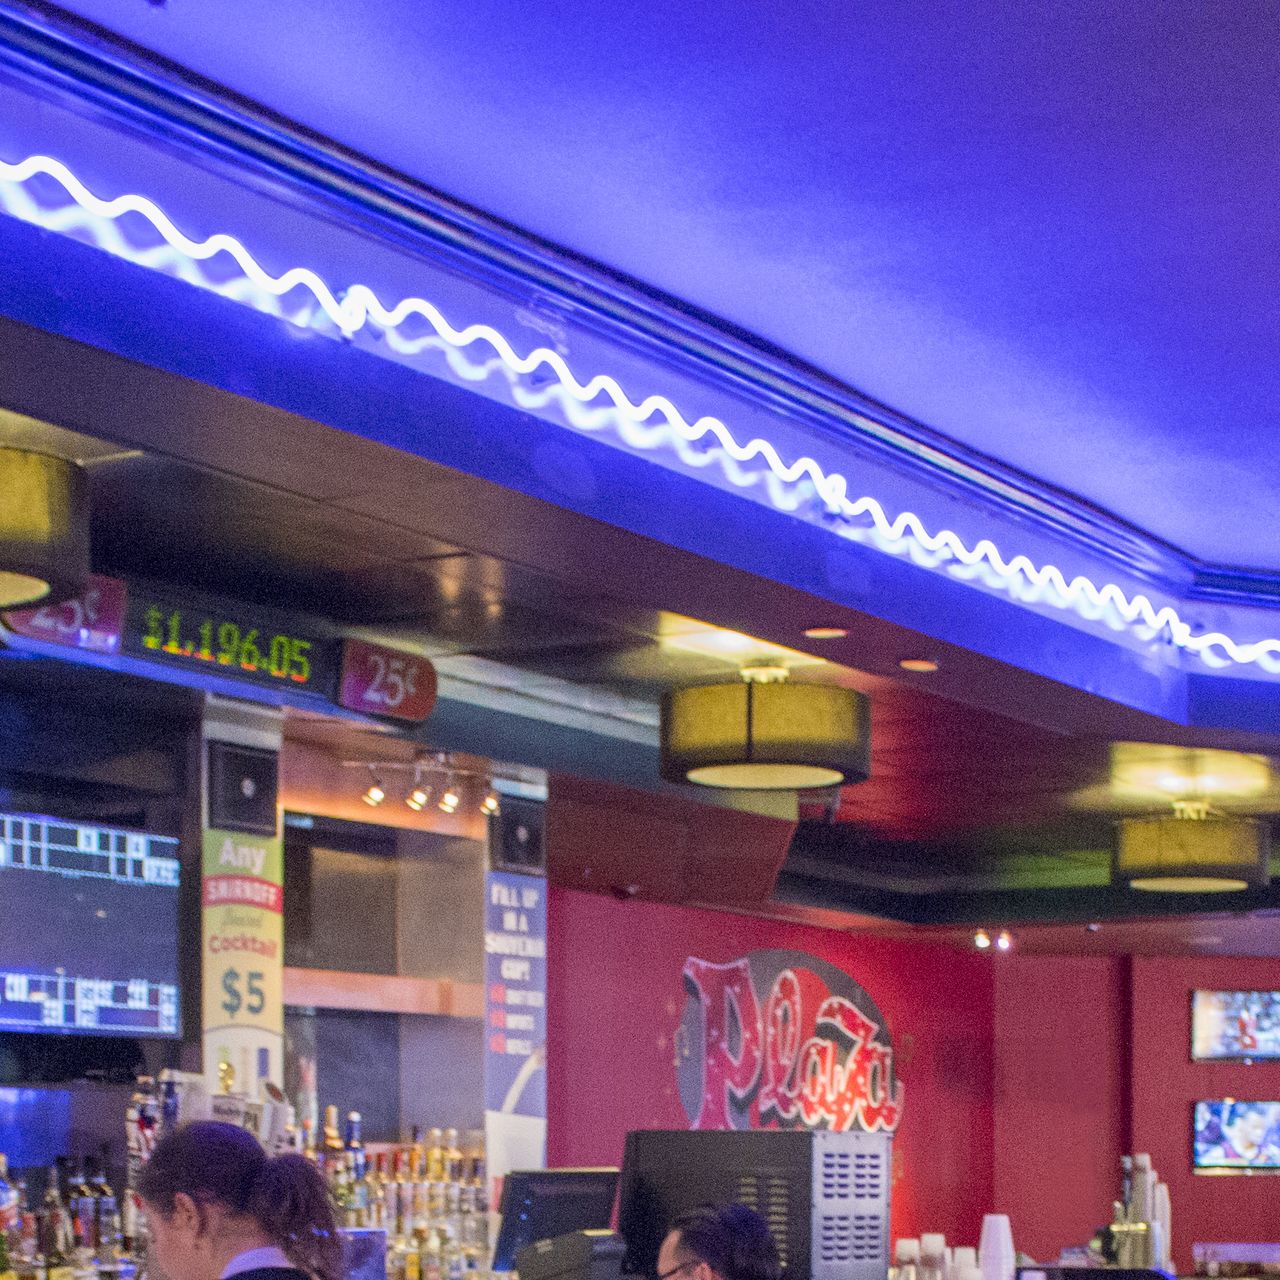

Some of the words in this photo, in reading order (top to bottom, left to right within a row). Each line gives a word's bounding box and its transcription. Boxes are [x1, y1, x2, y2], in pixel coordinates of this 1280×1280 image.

[366, 655, 419, 707] 25¢
[220, 838, 266, 874] Any
[207, 933, 278, 960] Cocktail
[221, 967, 265, 1018] $5
